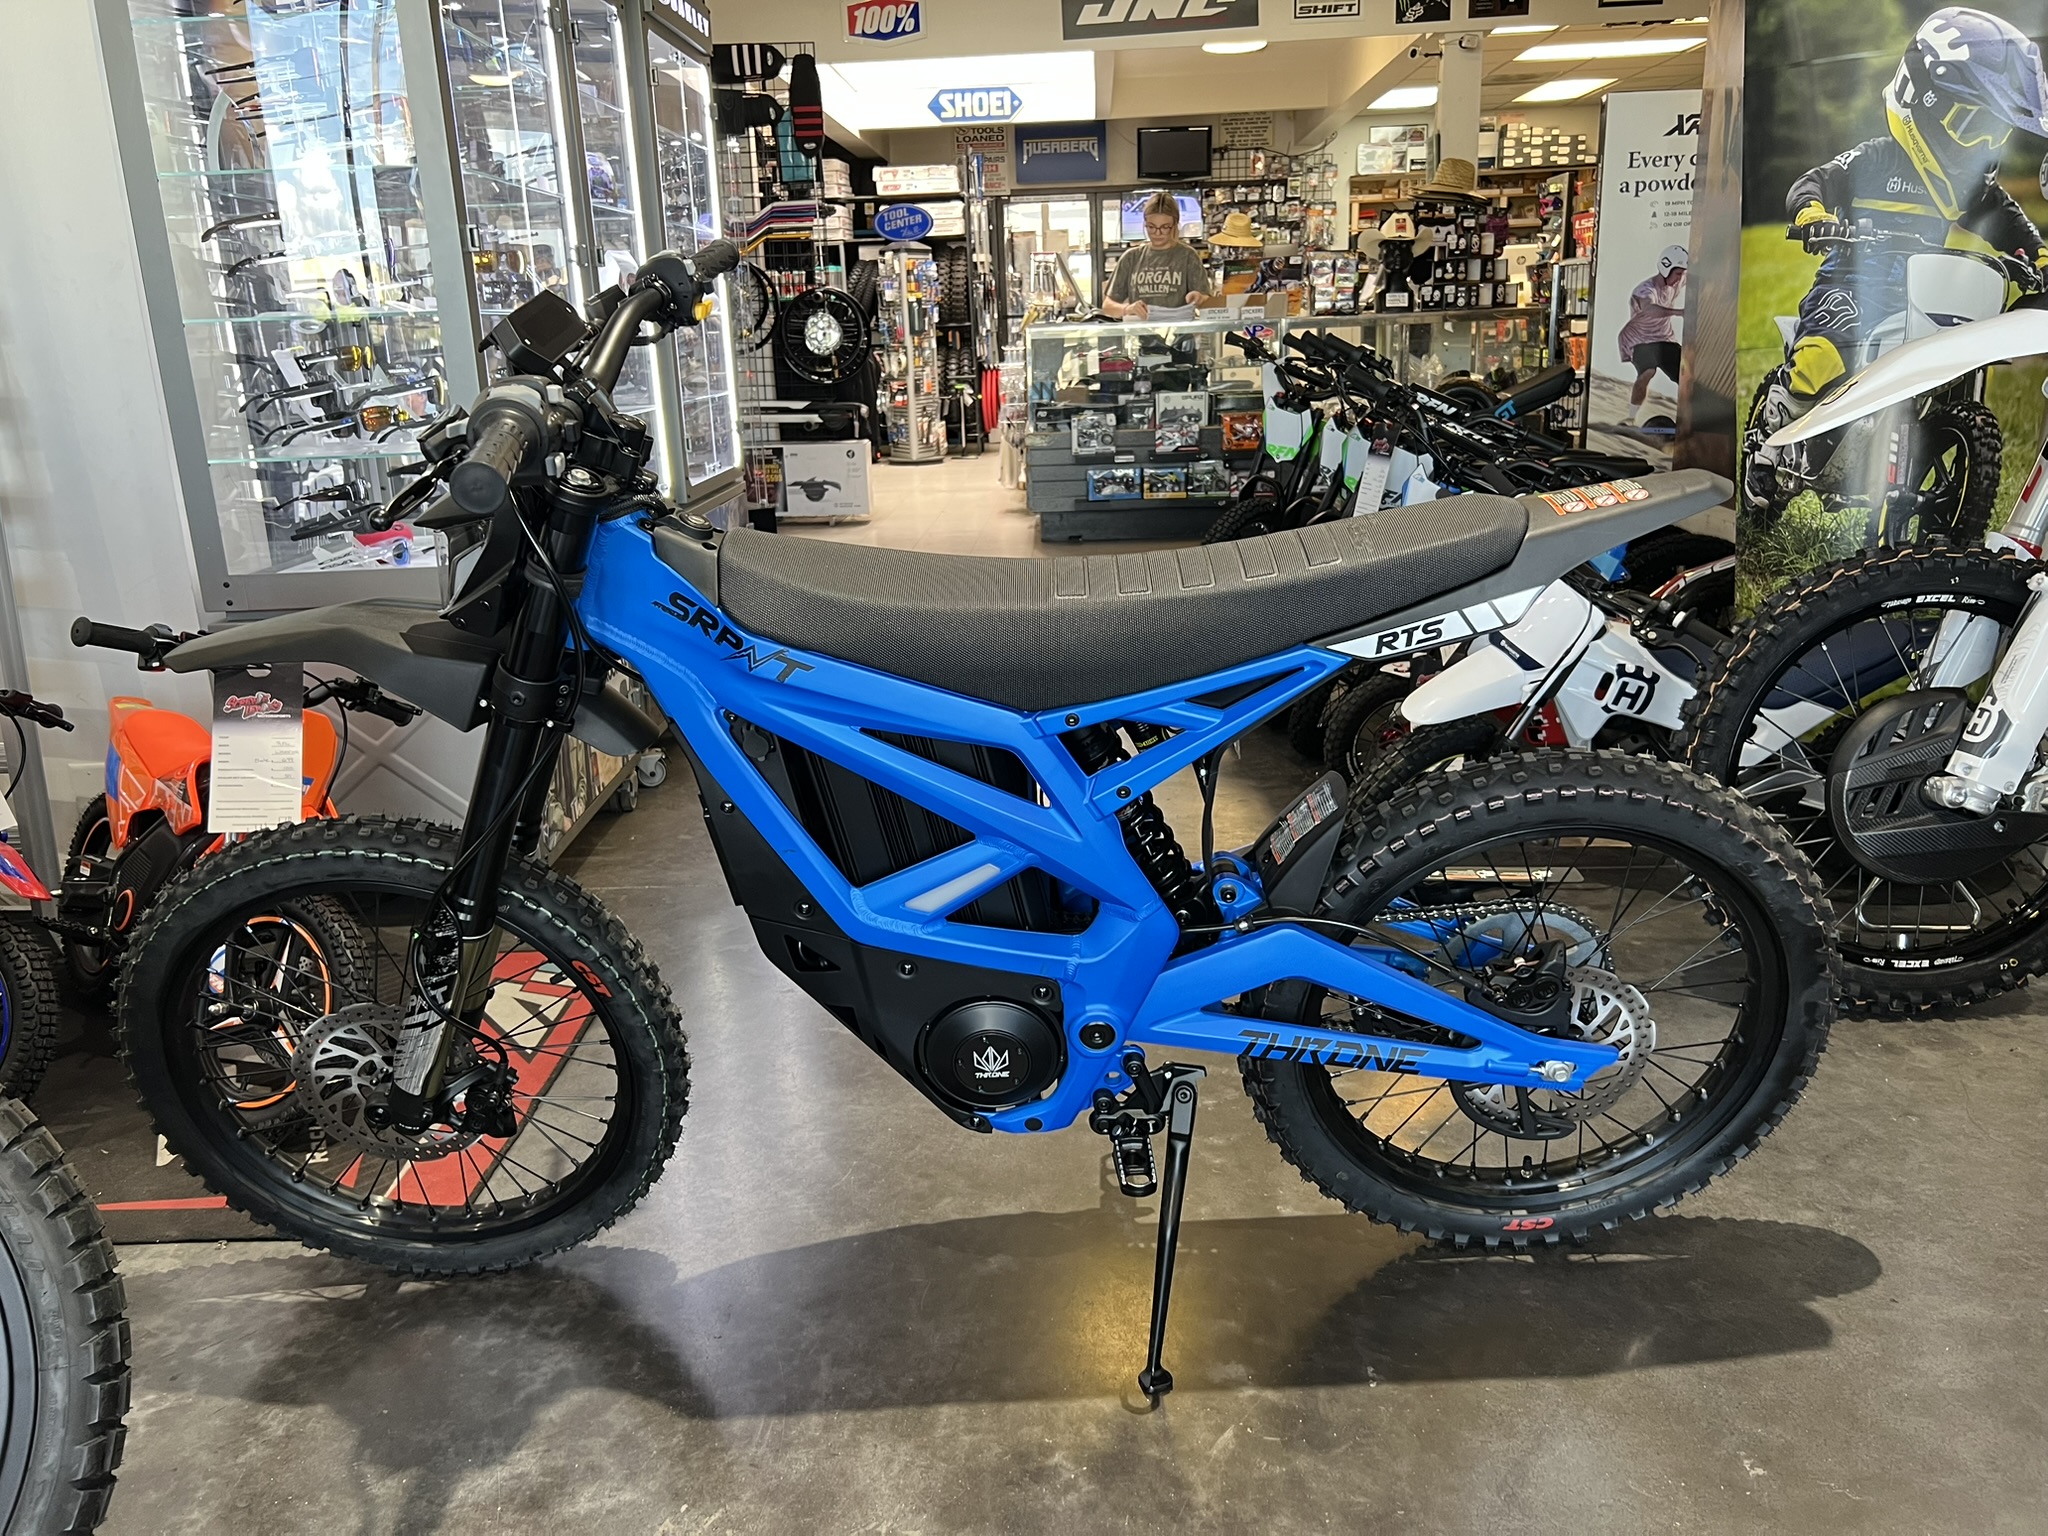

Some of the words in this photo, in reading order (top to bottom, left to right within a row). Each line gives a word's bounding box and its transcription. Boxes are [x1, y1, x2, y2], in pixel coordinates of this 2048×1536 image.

[1298, 4, 1357, 15] SHIFT
[854, 3, 915, 35] 100%
[938, 91, 1011, 118] SHOEI
[956, 135, 1005, 143] LOANED
[1023, 139, 1099, 163] HUSABERG
[1627, 151, 1686, 172] Every
[1619, 181, 1630, 193] a
[883, 208, 909, 221] TOOL
[884, 214, 922, 231] CENTER
[1575, 217, 1595, 228] LS2
[1131, 270, 1182, 286] MORGAN
[1138, 285, 1169, 294] WALLEN
[1915, 594, 1956, 603] EXCEL
[1375, 618, 1446, 655] RTS
[1891, 959, 1930, 968] EXCEL
[571, 959, 613, 998] CST
[1238, 1029, 1430, 1076] THRONE
[975, 1070, 1011, 1079] THRONE
[1503, 1217, 1555, 1231] CST
